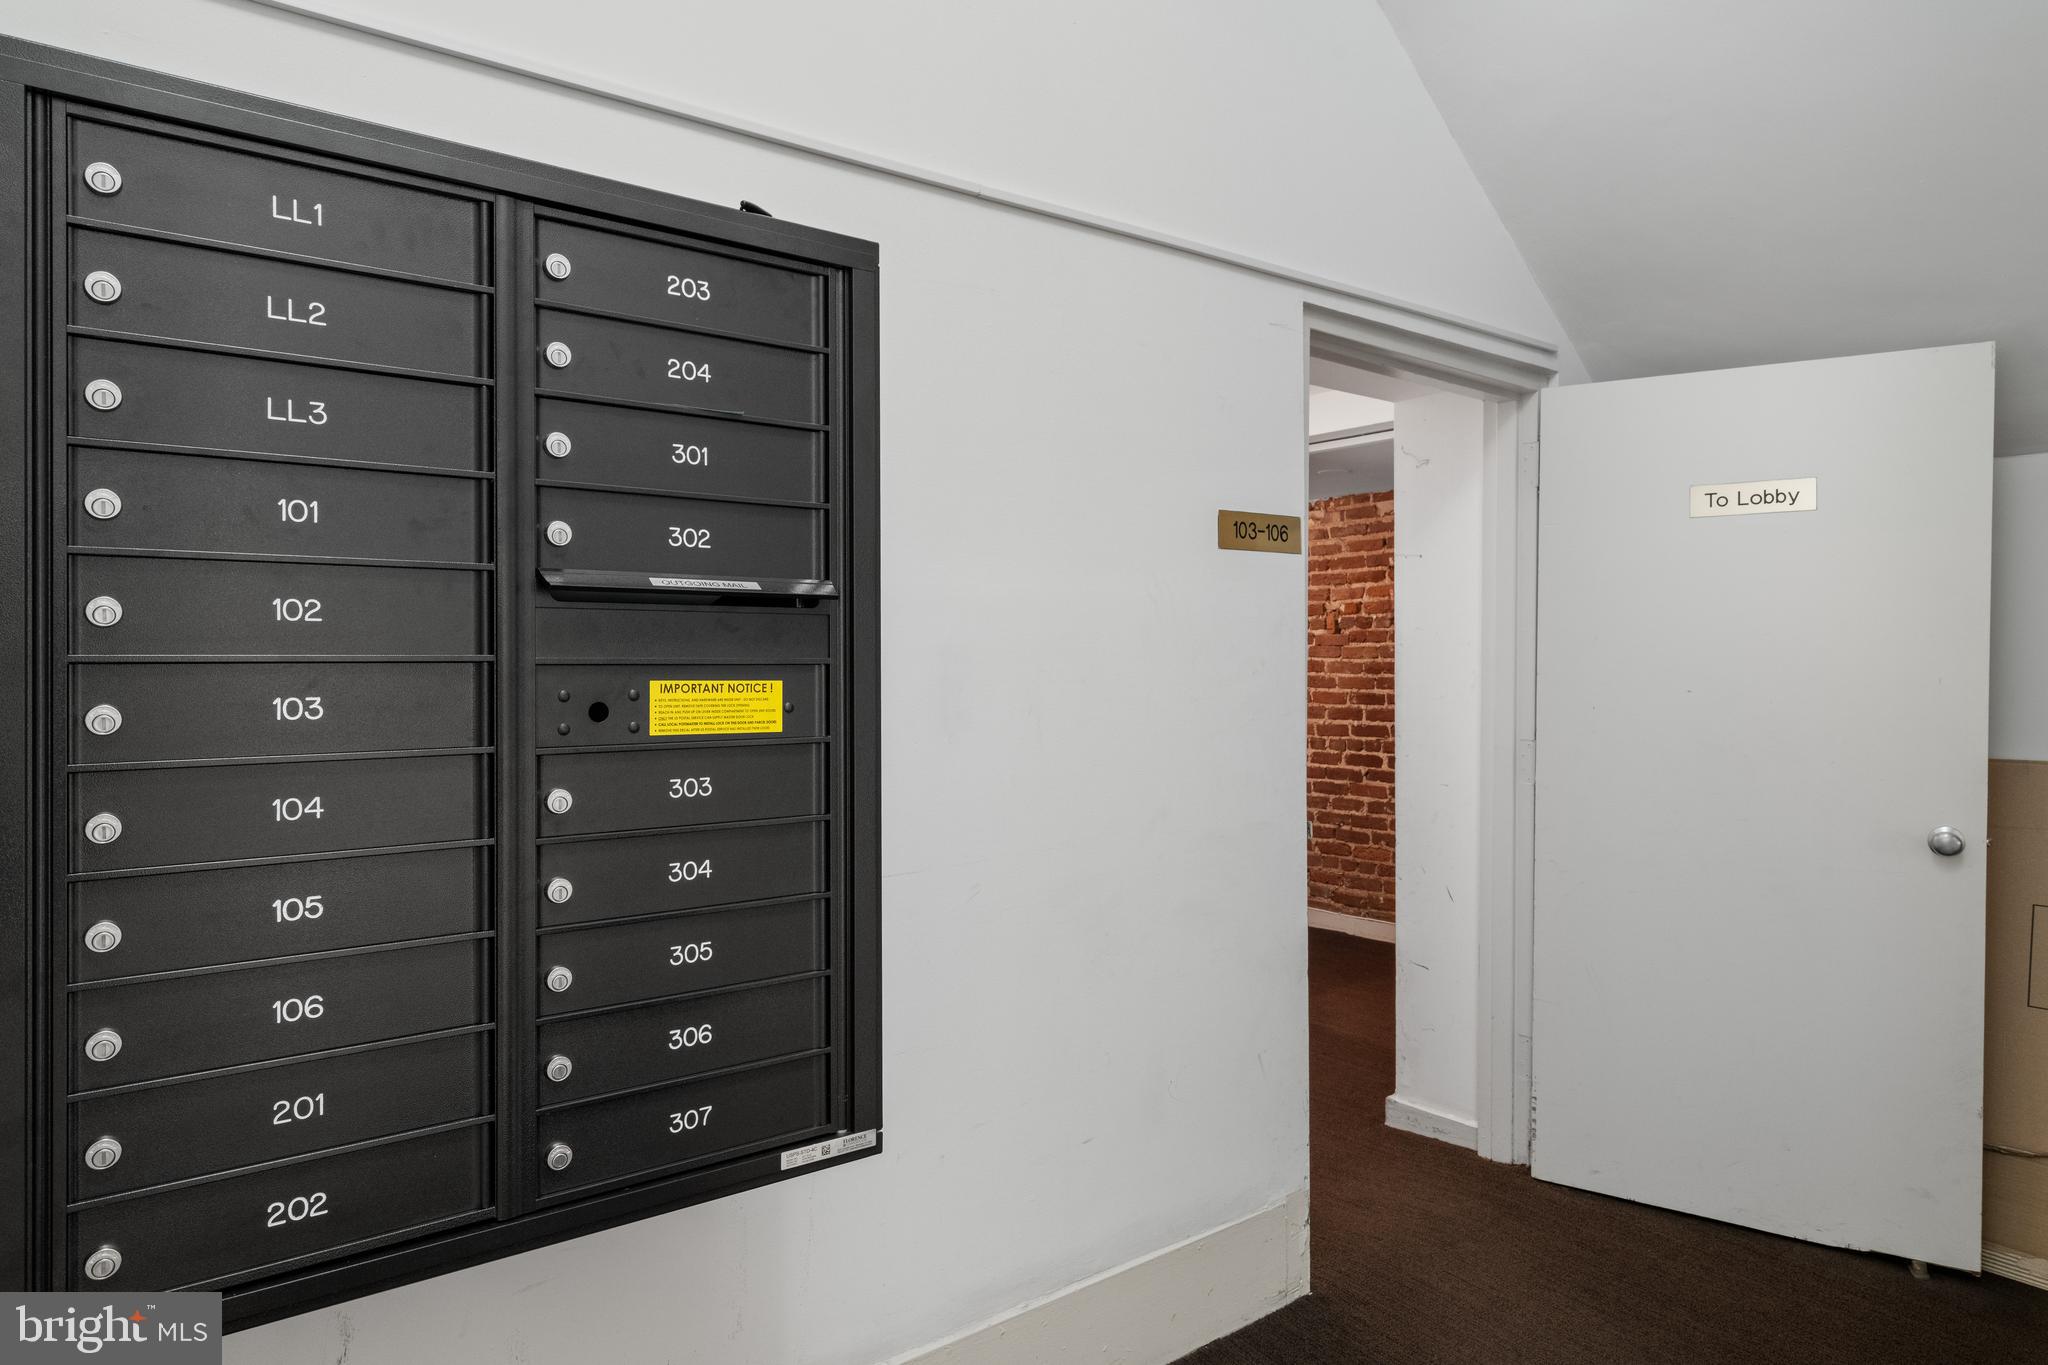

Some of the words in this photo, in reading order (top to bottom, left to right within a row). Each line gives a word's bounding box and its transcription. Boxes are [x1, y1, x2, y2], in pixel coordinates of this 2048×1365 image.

[272, 195, 322, 226] LL1
[668, 275, 710, 301] 203
[267, 296, 327, 326] LL2
[668, 359, 711, 383] 204
[267, 397, 327, 424] LL3
[672, 444, 707, 466] 301
[1704, 491, 1729, 508] To
[1737, 488, 1800, 509] Lobby
[278, 499, 318, 523] 101
[669, 527, 711, 548] 302
[1232, 520, 1289, 543] 103-106
[661, 579, 721, 587] OUTGOING
[273, 598, 322, 621] 102
[660, 683, 724, 694] IMPORTANT
[727, 683, 767, 693] NOTICE
[273, 697, 323, 720] 103
[669, 777, 712, 798] 303
[272, 797, 324, 821] 104
[669, 860, 712, 882] 304
[272, 895, 323, 922] 105
[670, 942, 712, 965] 305
[273, 995, 323, 1023] 106
[669, 1024, 712, 1049] 306
[274, 1093, 323, 1124] 201
[670, 1106, 712, 1133] 307
[268, 1193, 328, 1227] 202
